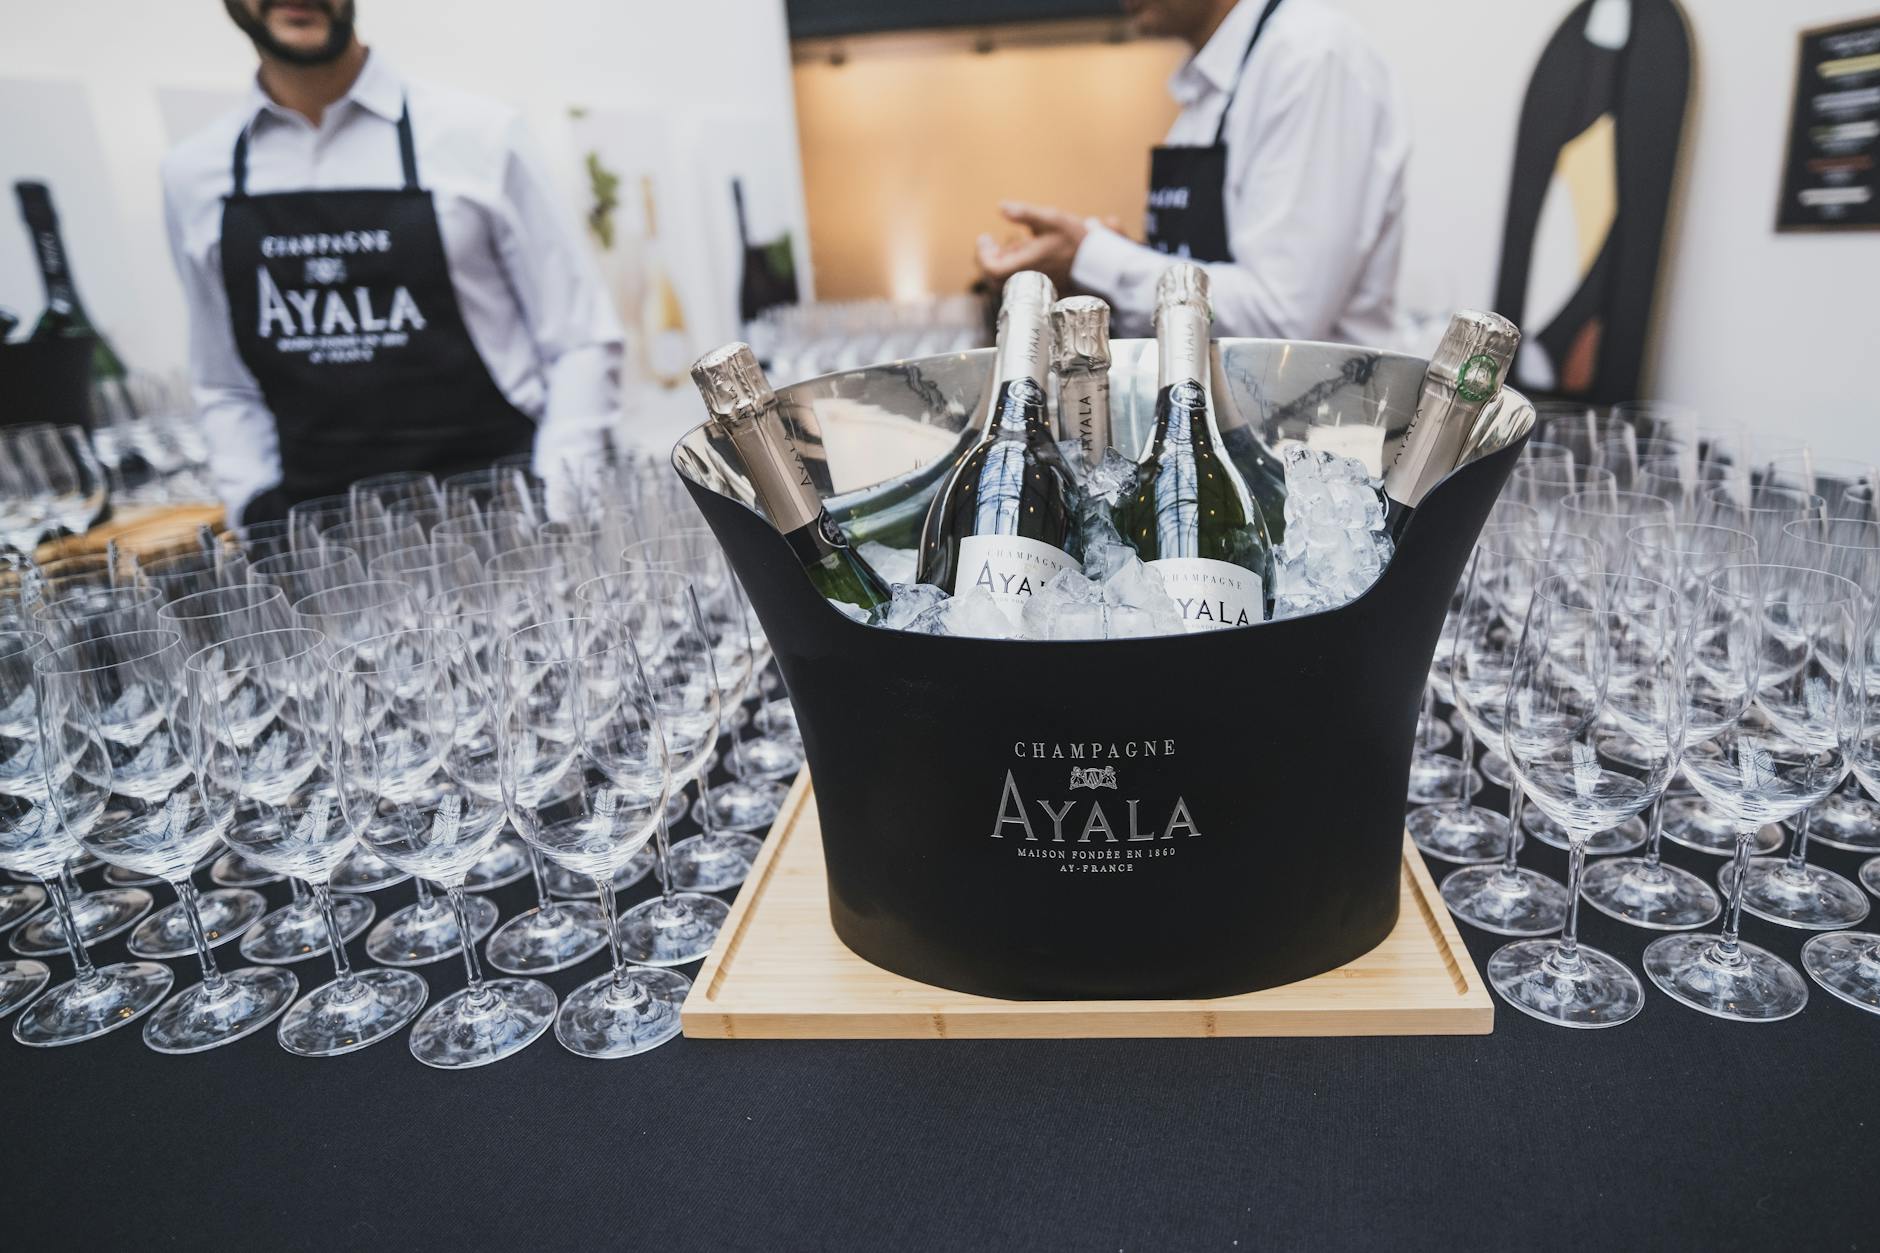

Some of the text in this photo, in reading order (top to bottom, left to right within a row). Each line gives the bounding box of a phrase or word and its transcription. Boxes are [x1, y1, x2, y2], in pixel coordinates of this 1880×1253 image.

[257, 265, 426, 338] AYALA
[976, 559, 1045, 597] AYA
[1176, 598, 1249, 627] YALA
[1014, 739, 1176, 759] CHAMPAGNE
[990, 768, 1202, 842] AYALA
[1017, 847, 1176, 860] MAISON FONDÉE EN 1860
[1059, 863, 1134, 873] AY-FRANCE
